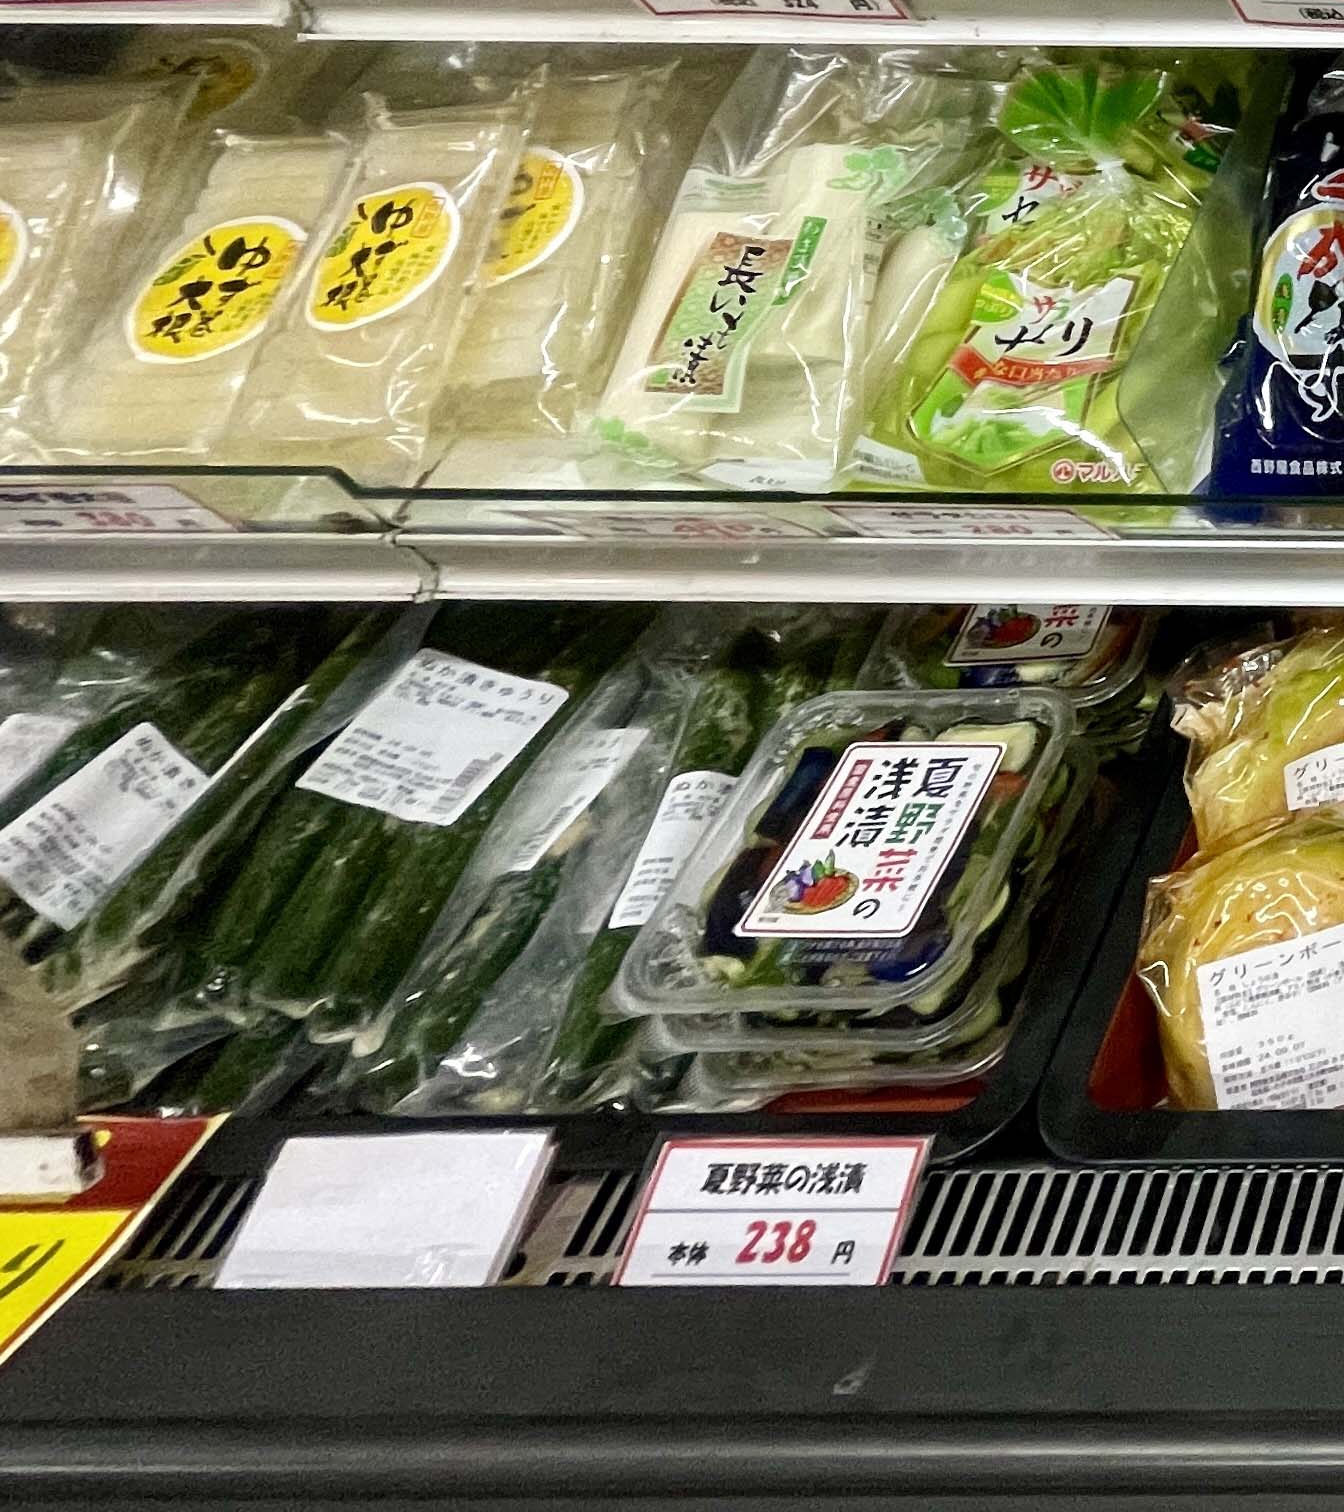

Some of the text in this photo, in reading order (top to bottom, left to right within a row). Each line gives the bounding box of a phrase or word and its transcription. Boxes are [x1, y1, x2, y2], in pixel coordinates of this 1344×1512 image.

[834, 757, 920, 849] 浅漬
[851, 755, 970, 921] 夏野菜の
[700, 1163, 868, 1196] 夏野菜の浅漬
[667, 1219, 856, 1266] 本体 238 円
